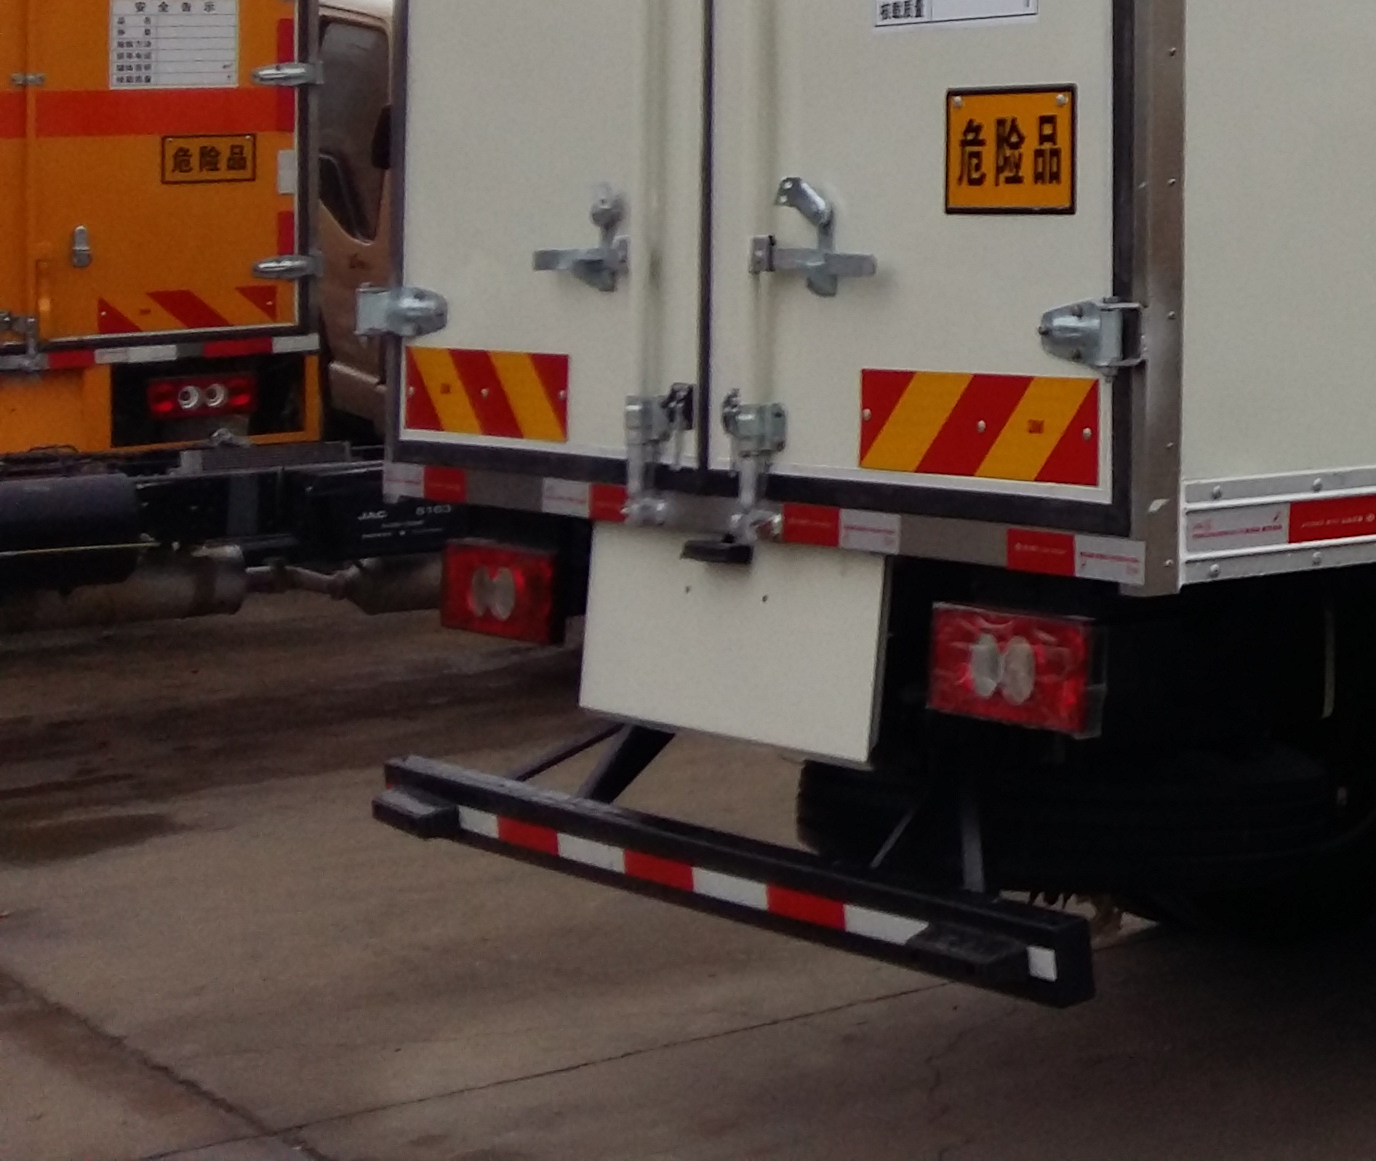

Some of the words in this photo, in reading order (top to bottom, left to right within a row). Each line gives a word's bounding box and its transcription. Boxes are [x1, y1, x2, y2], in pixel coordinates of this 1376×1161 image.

[171, 144, 247, 173] 危险品
[956, 113, 1063, 187] 危险品
